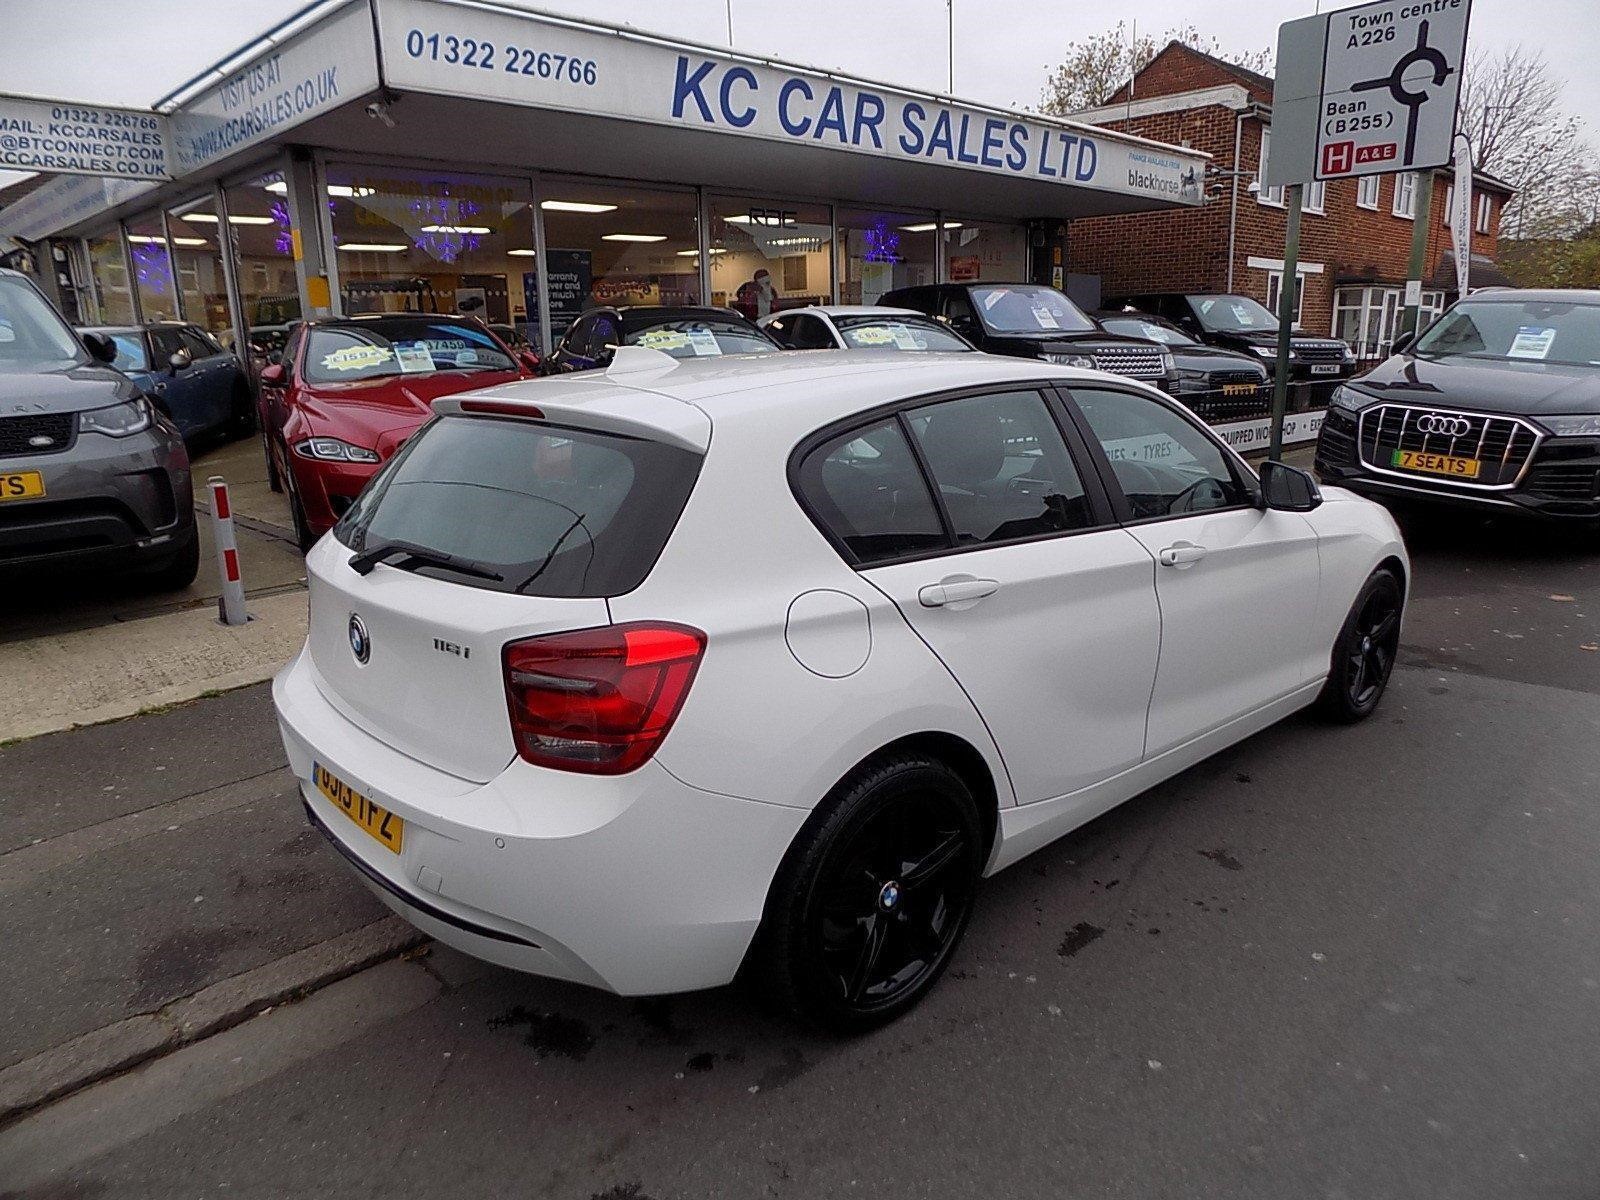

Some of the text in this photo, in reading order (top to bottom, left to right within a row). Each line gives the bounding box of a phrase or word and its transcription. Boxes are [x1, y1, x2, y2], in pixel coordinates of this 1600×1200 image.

[1349, 0, 1461, 31] Town centre
[1346, 26, 1396, 49] A226
[406, 29, 598, 86] 01322 226766
[219, 54, 283, 111] VISIT US AT
[52, 107, 157, 130] 01322 226766
[671, 55, 1098, 182] KC CAR SALES LTD
[1326, 100, 1367, 116] Bean
[49, 123, 162, 146] KCCARSALES
[1325, 111, 1394, 137] (B255)
[0, 133, 164, 161] @BTCONNECT.COM
[1326, 144, 1349, 172] H
[1128, 169, 1179, 194] blackhorse
[548, 272, 579, 282] arranty
[1218, 428, 1254, 444] QUIPPED
[1144, 442, 1172, 459] TYRES
[1403, 452, 1467, 473] 7 SEATS
